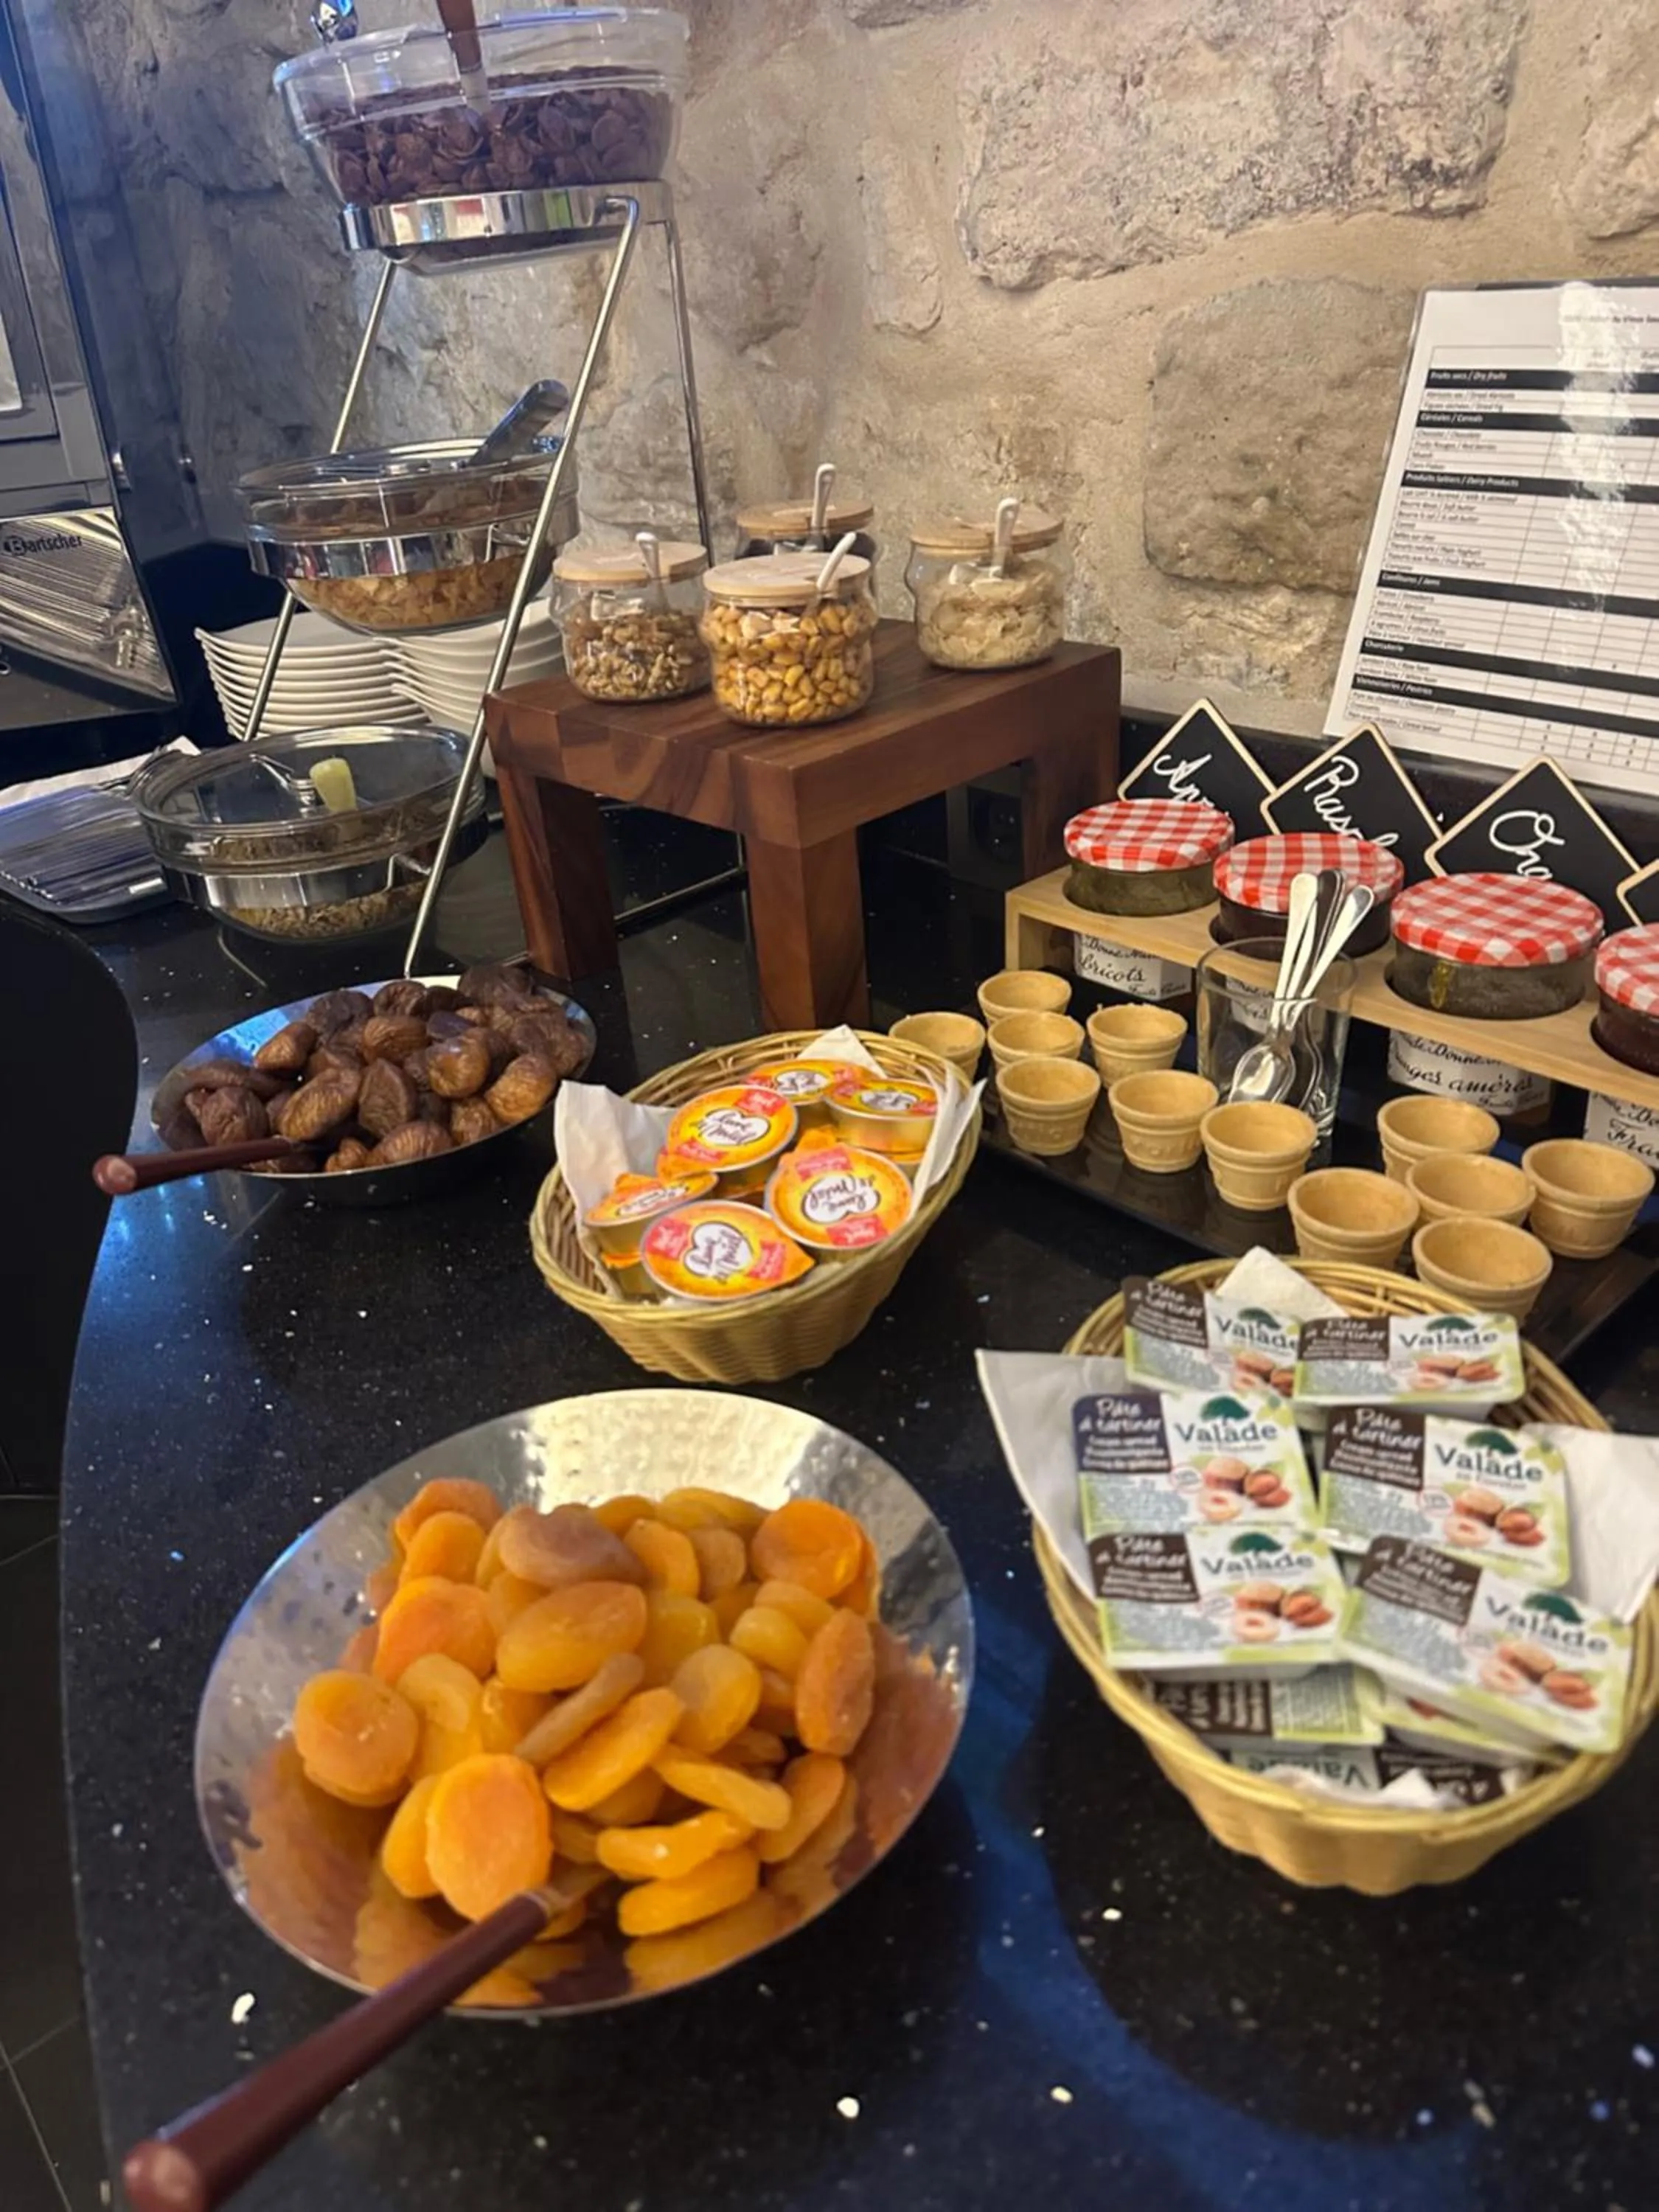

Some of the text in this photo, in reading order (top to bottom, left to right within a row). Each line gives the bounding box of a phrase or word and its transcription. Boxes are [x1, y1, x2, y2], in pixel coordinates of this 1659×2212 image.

[3, 533, 83, 557] Bartscher
[1398, 1330, 1500, 1348] Valade
[1172, 1420, 1279, 1443] Valade
[1434, 1443, 1544, 1483] Valade
[1199, 1554, 1314, 1576] Valade
[1486, 1595, 1609, 1652] Valade
